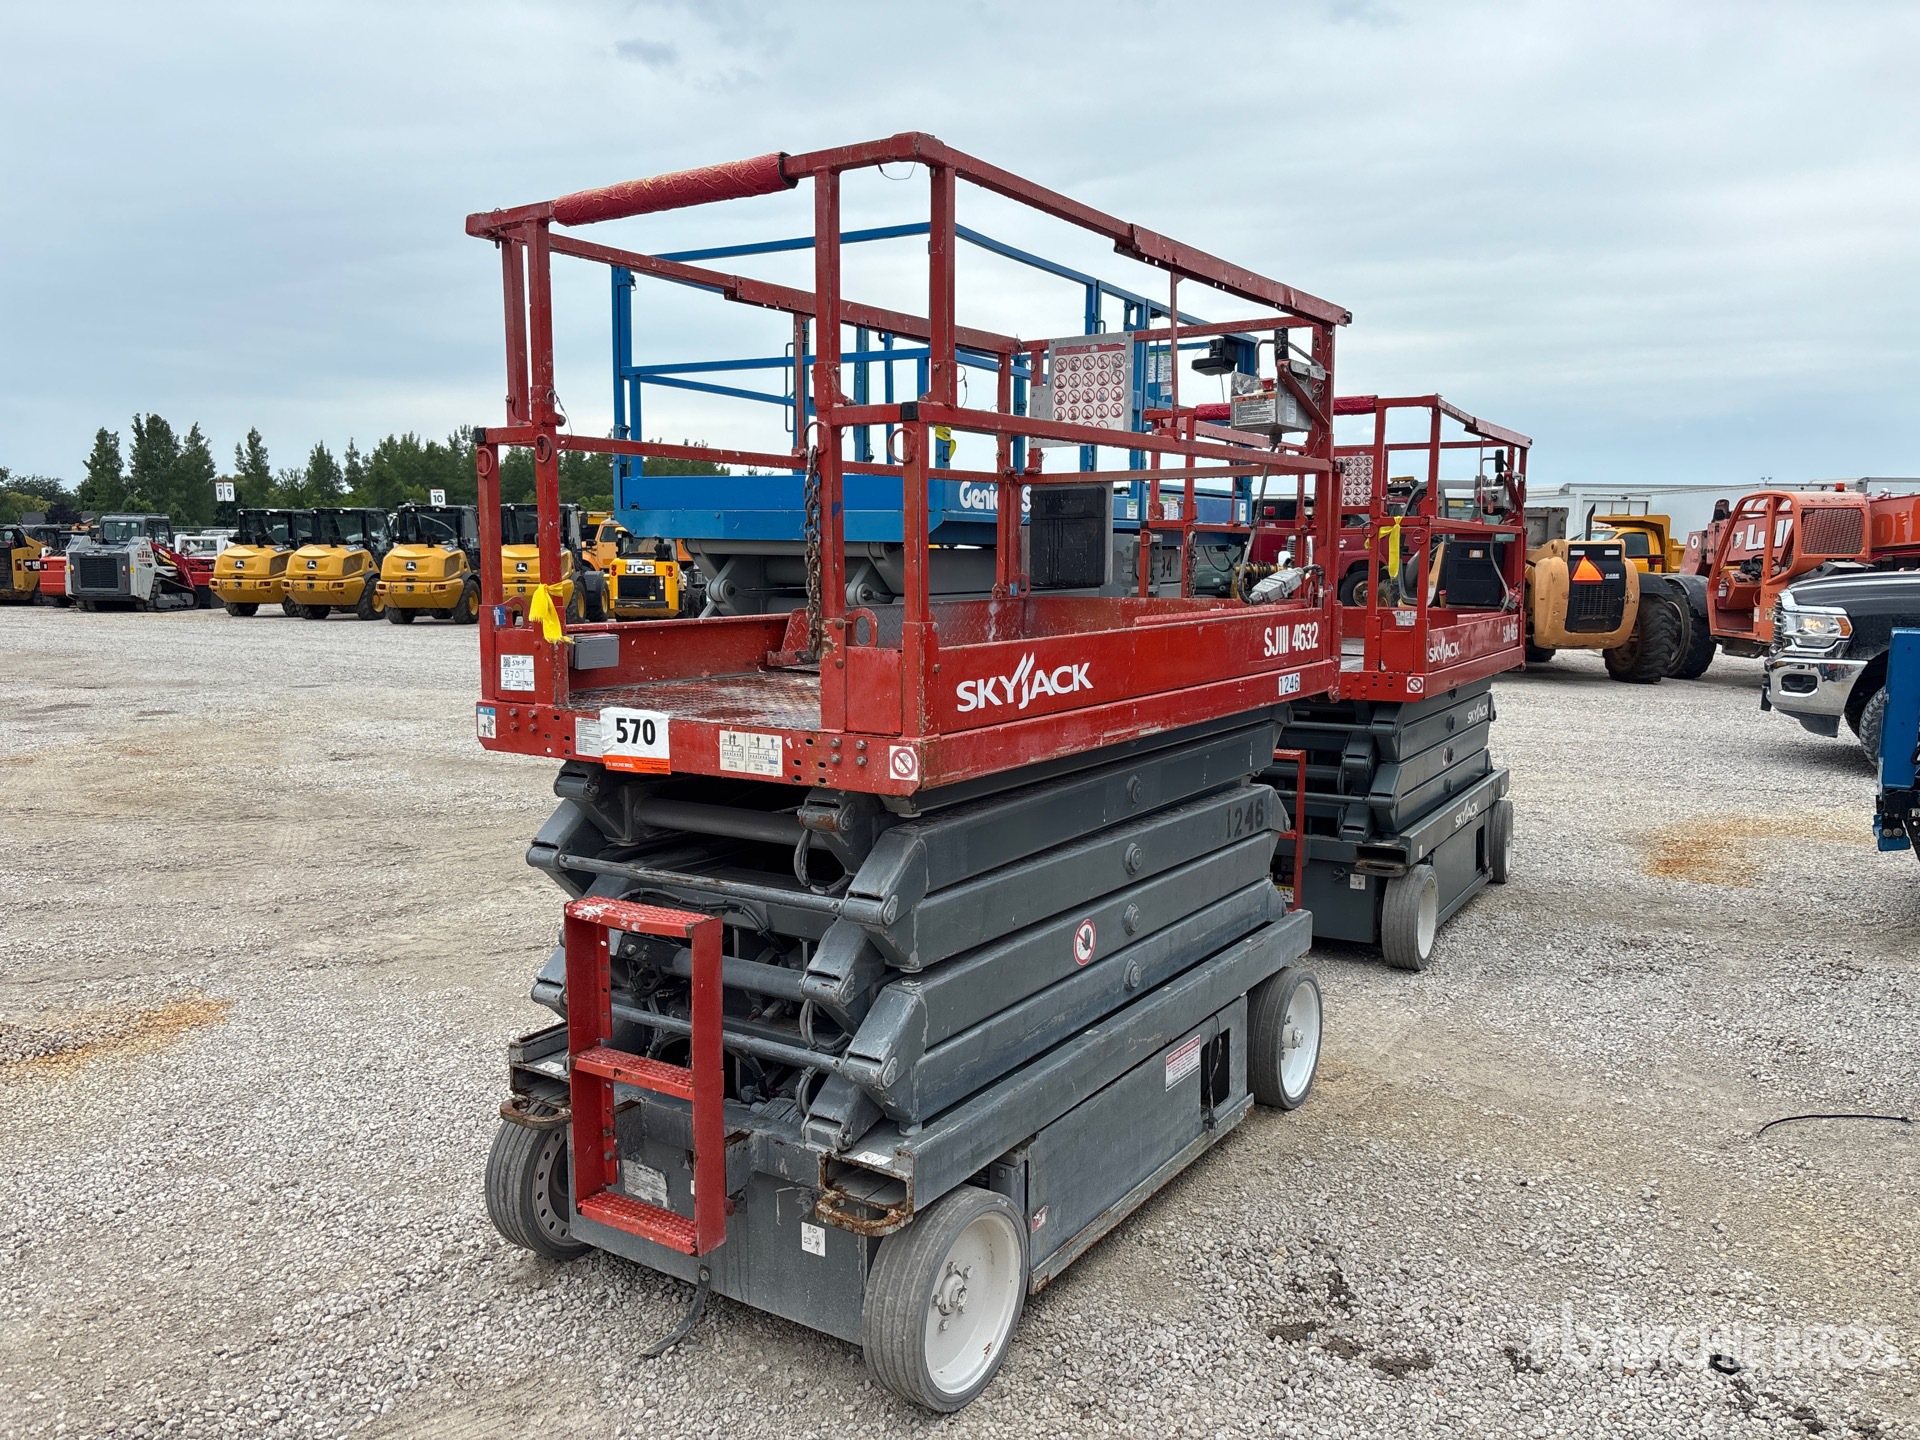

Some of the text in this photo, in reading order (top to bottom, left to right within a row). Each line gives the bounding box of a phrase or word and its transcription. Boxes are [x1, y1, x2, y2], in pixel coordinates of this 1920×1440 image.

[433, 494, 443, 503] 10
[626, 565, 655, 574] JCB
[1291, 621, 1319, 652] 4632
[1428, 635, 1460, 664] SKYJACK
[955, 651, 1094, 713] SKYJACK
[1279, 674, 1300, 695] 1246
[1467, 701, 1489, 724] SKYJACK
[616, 717, 656, 746] 570
[1226, 798, 1264, 839] 1246
[1455, 800, 1479, 828] SKYJACK
